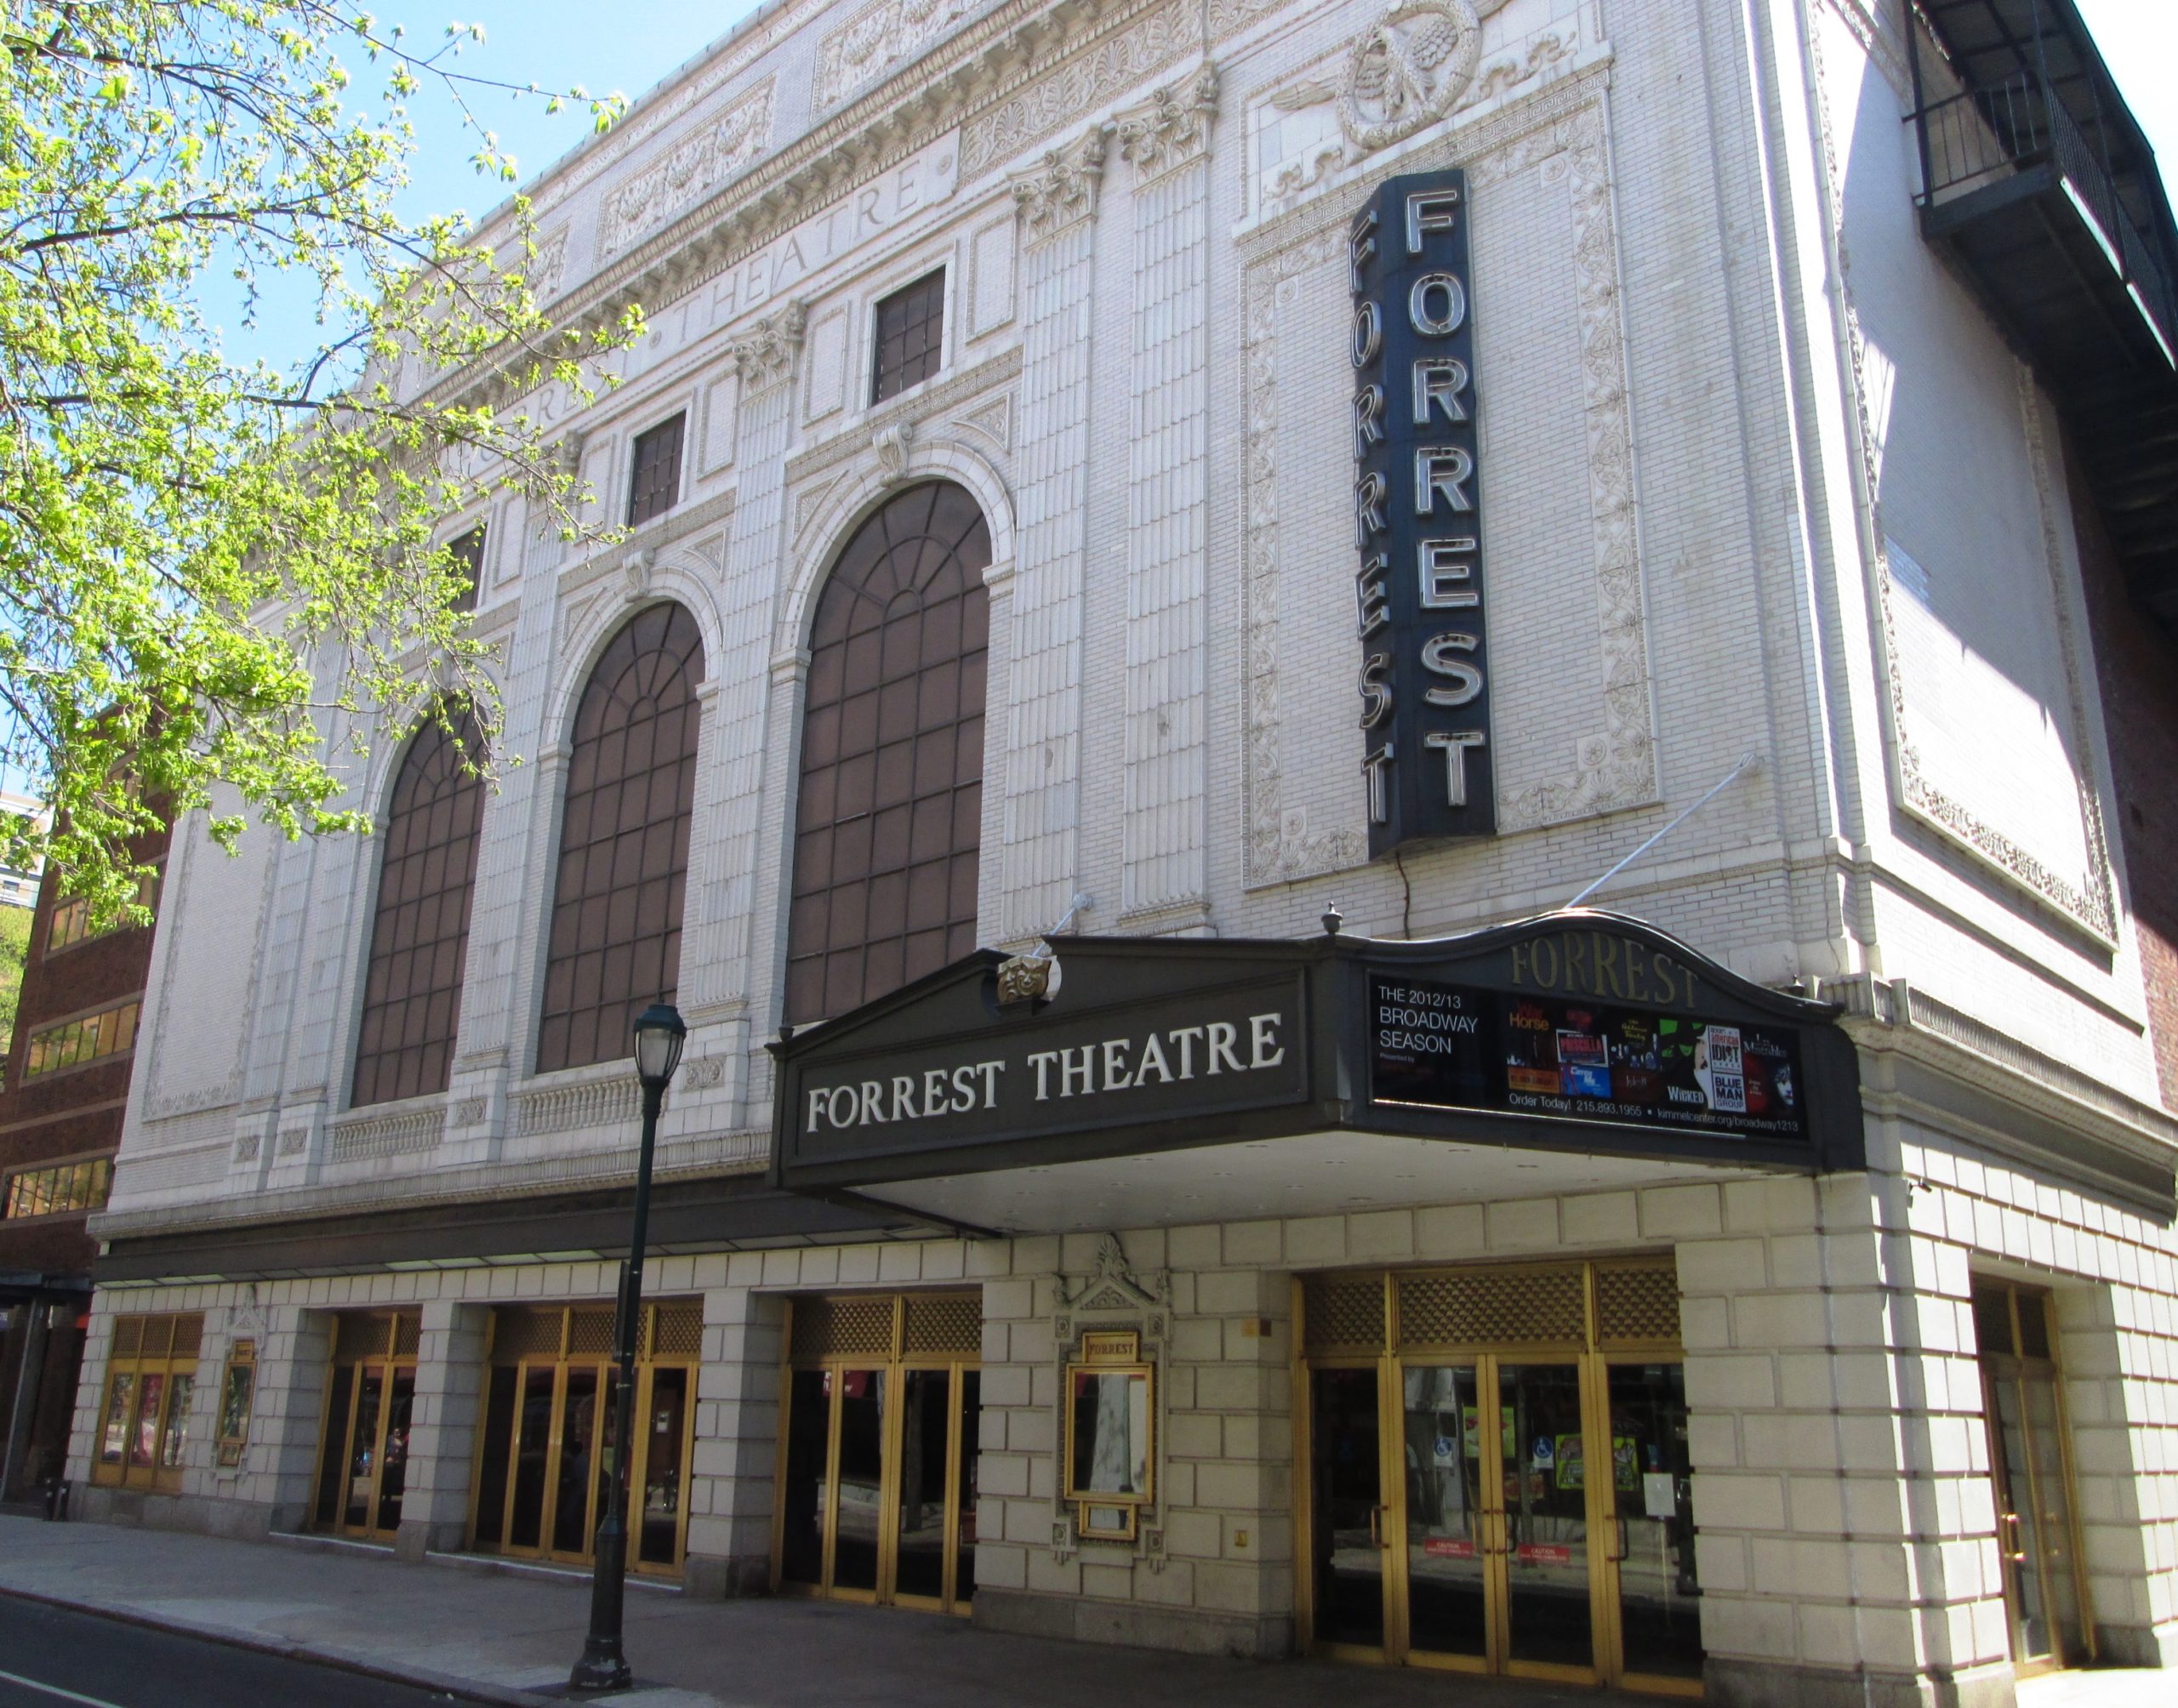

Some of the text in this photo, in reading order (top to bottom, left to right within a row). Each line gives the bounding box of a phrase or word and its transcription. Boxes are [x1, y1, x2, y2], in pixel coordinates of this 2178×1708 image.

[673, 158, 921, 344] THEATRE
[1405, 189, 1487, 807] FORREST
[1348, 210, 1394, 828] FORREST
[1510, 931, 1698, 1009] FORREST
[1378, 985, 1462, 1010] THE 2012/13
[1379, 1006, 1479, 1033] BROADWAY
[1508, 1011, 1550, 1032] Horse
[1379, 1029, 1452, 1055] SEASON
[1379, 1052, 1415, 1063] Presented by
[806, 1012, 1286, 1133] FORREST THEATRE
[1714, 1076, 1742, 1088] BLUE
[1715, 1087, 1743, 1100] MAN
[1716, 1098, 1744, 1109] GROUP
[1508, 1092, 1799, 1131] Order Today! 215.893.1955 kimmelcenter.org/broadway1213
[1088, 1343, 1134, 1356] FORREST
